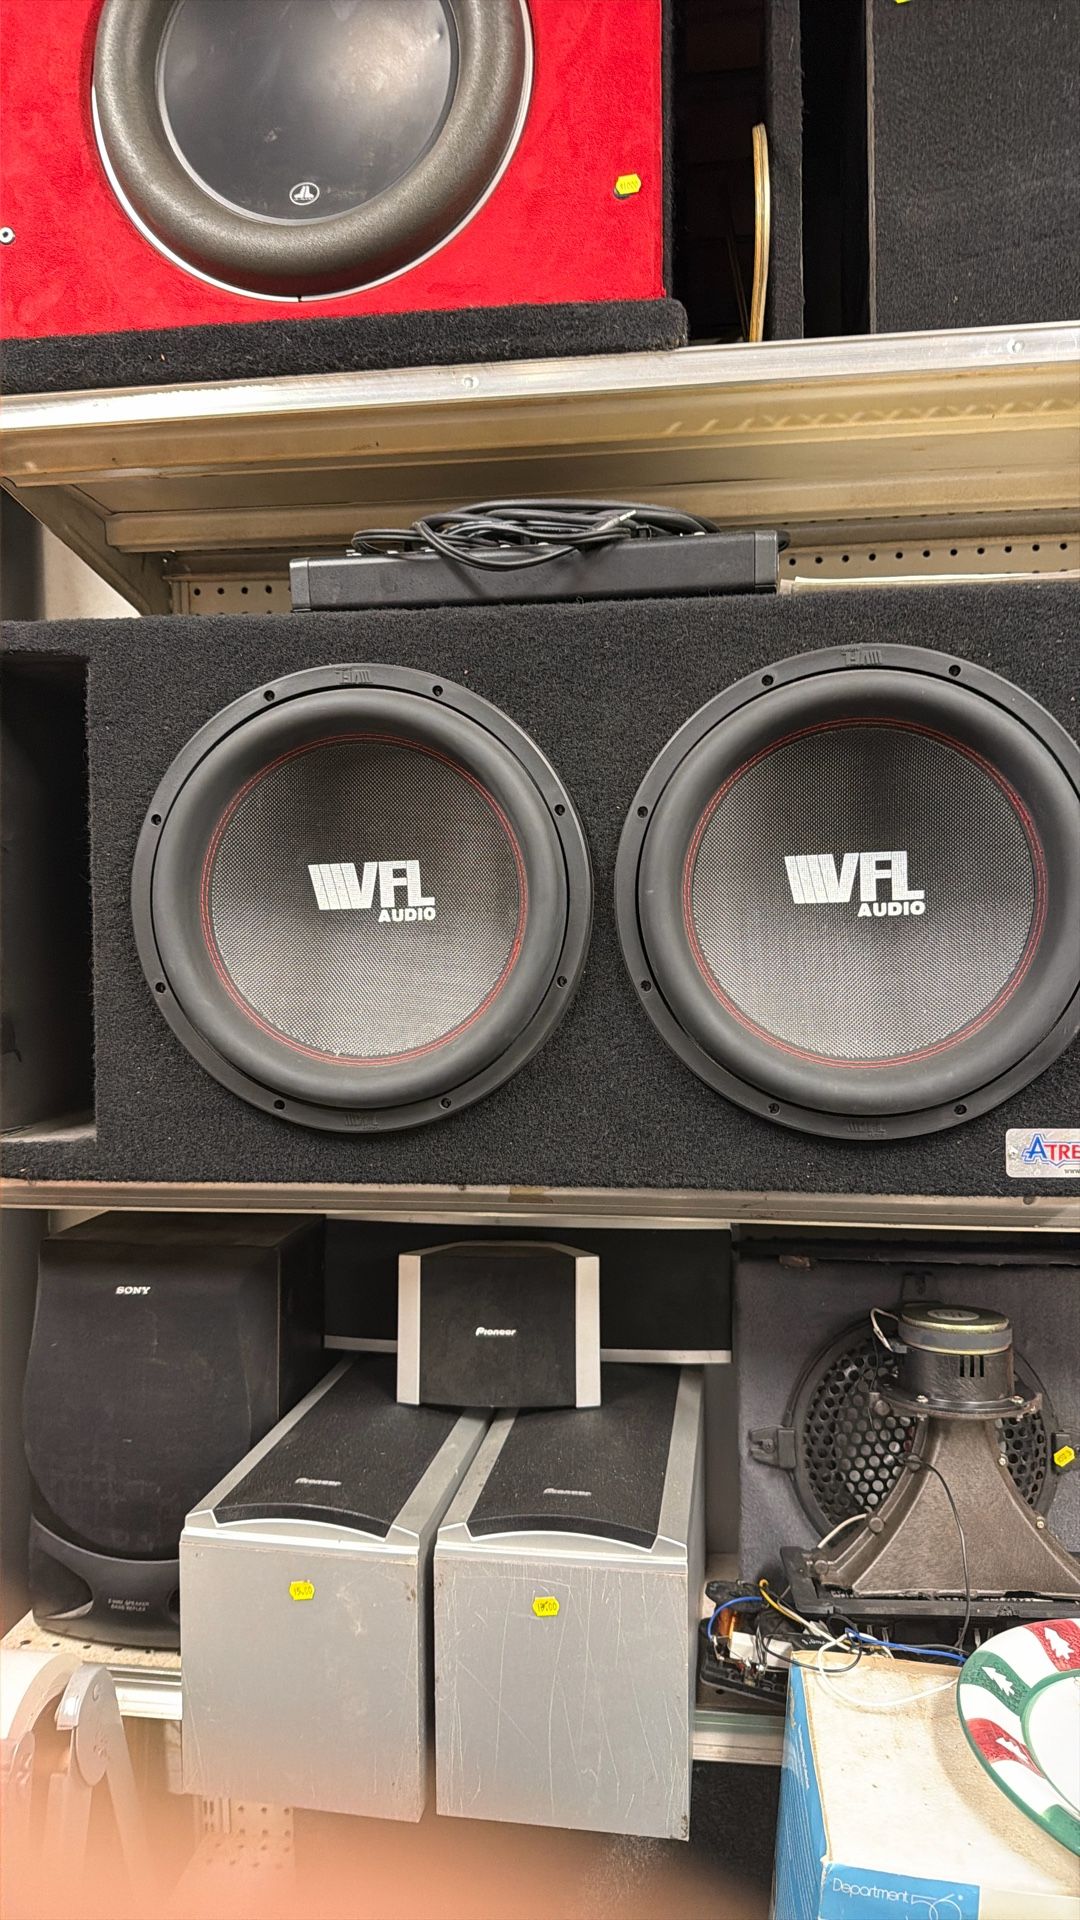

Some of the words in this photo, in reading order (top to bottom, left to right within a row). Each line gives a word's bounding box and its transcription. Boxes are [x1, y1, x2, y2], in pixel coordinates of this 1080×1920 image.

[378, 907, 436, 922] AUDIO
[858, 901, 926, 917] AUDIO
[115, 1286, 151, 1295] SONY
[475, 1326, 517, 1337] Pioneer
[832, 1877, 909, 1904] Department
